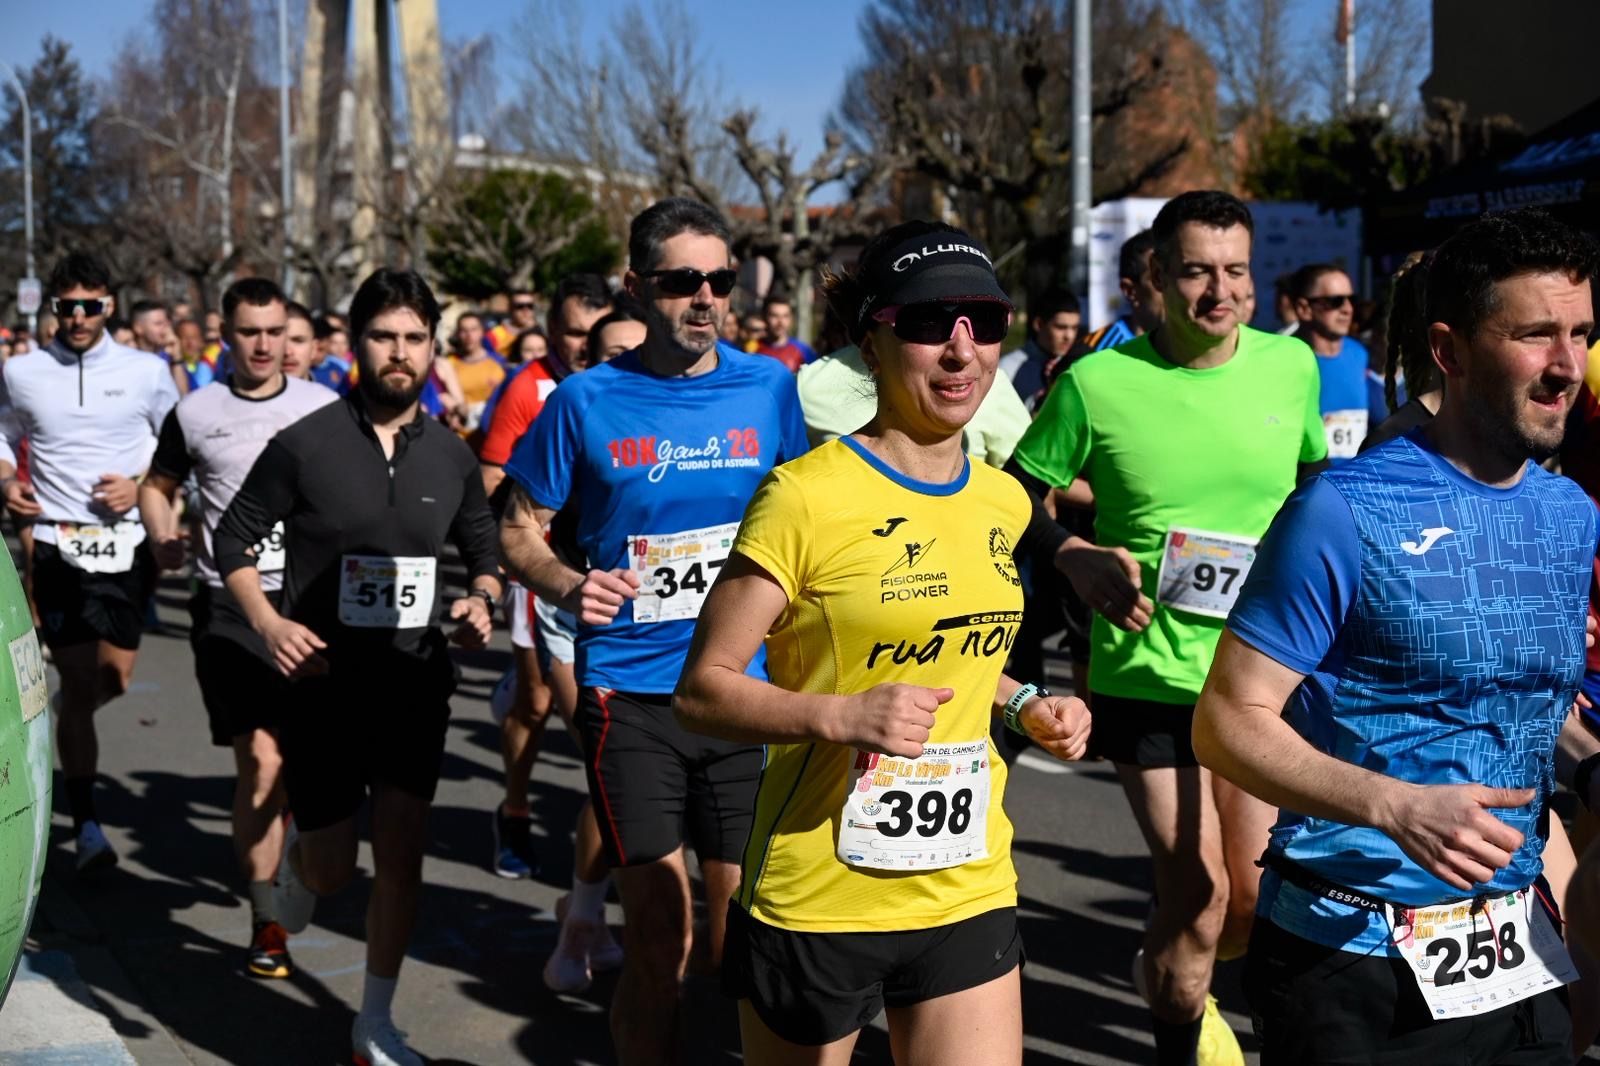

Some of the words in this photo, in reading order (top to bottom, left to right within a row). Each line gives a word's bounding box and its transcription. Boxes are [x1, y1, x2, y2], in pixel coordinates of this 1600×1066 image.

[608, 436, 658, 467] 10K
[677, 459, 710, 471] CIUDAD
[711, 458, 723, 469] DE
[725, 457, 760, 468] ASTORGA
[70, 540, 116, 558] 344
[880, 571, 947, 588] FISIORAMA
[1192, 563, 1240, 595] 97
[357, 582, 416, 608] 515
[880, 584, 949, 604] POWER
[968, 612, 1023, 625] cenad
[866, 634, 945, 670] rua
[875, 787, 973, 837] 398
[1425, 921, 1525, 988] 258
